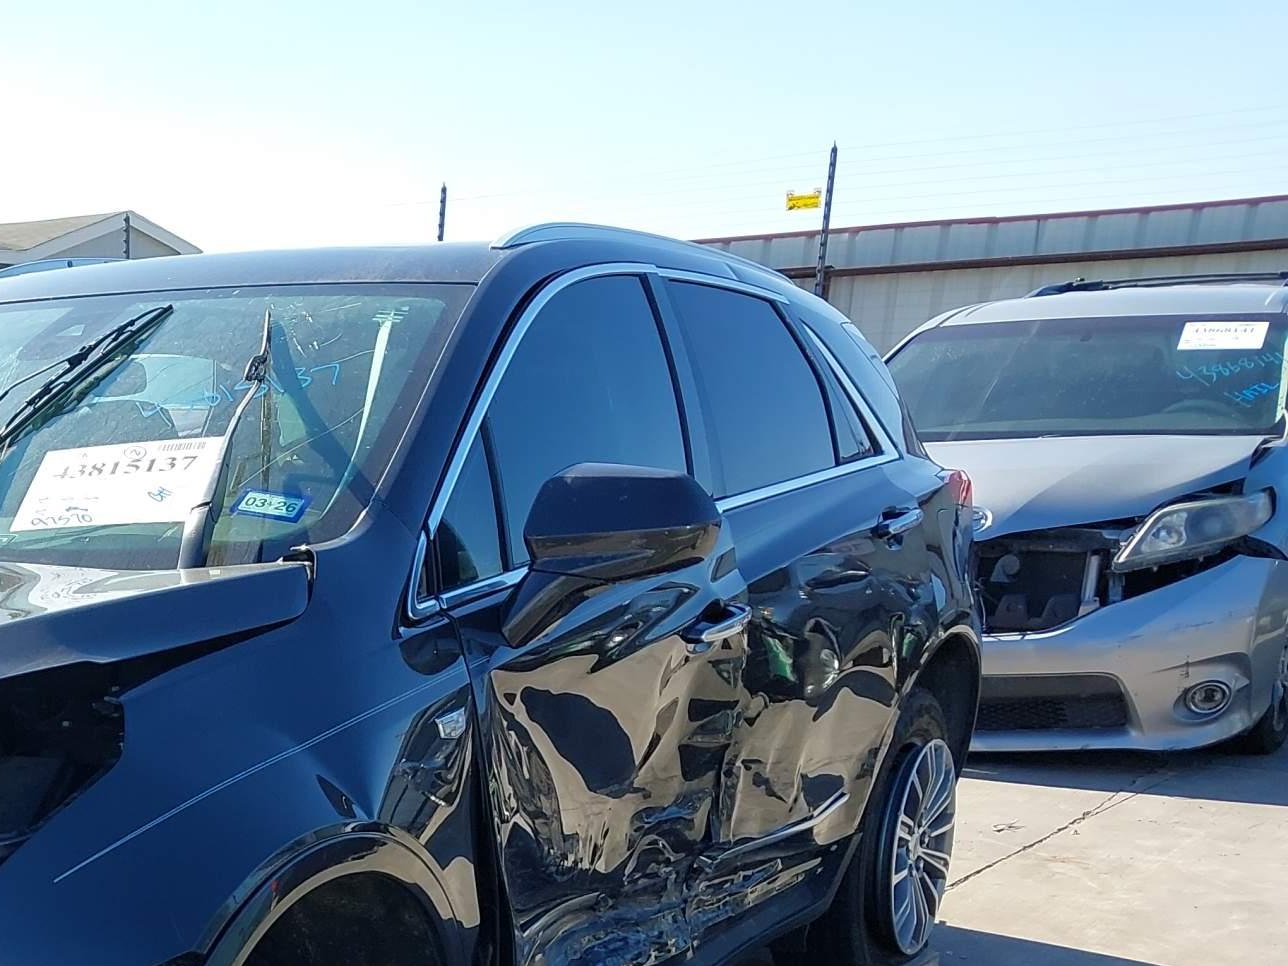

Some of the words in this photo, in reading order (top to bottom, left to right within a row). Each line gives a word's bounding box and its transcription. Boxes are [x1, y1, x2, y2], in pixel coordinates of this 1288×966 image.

[52, 455, 199, 479] 43815137
[244, 496, 268, 508] 03
[274, 500, 298, 513] 26
